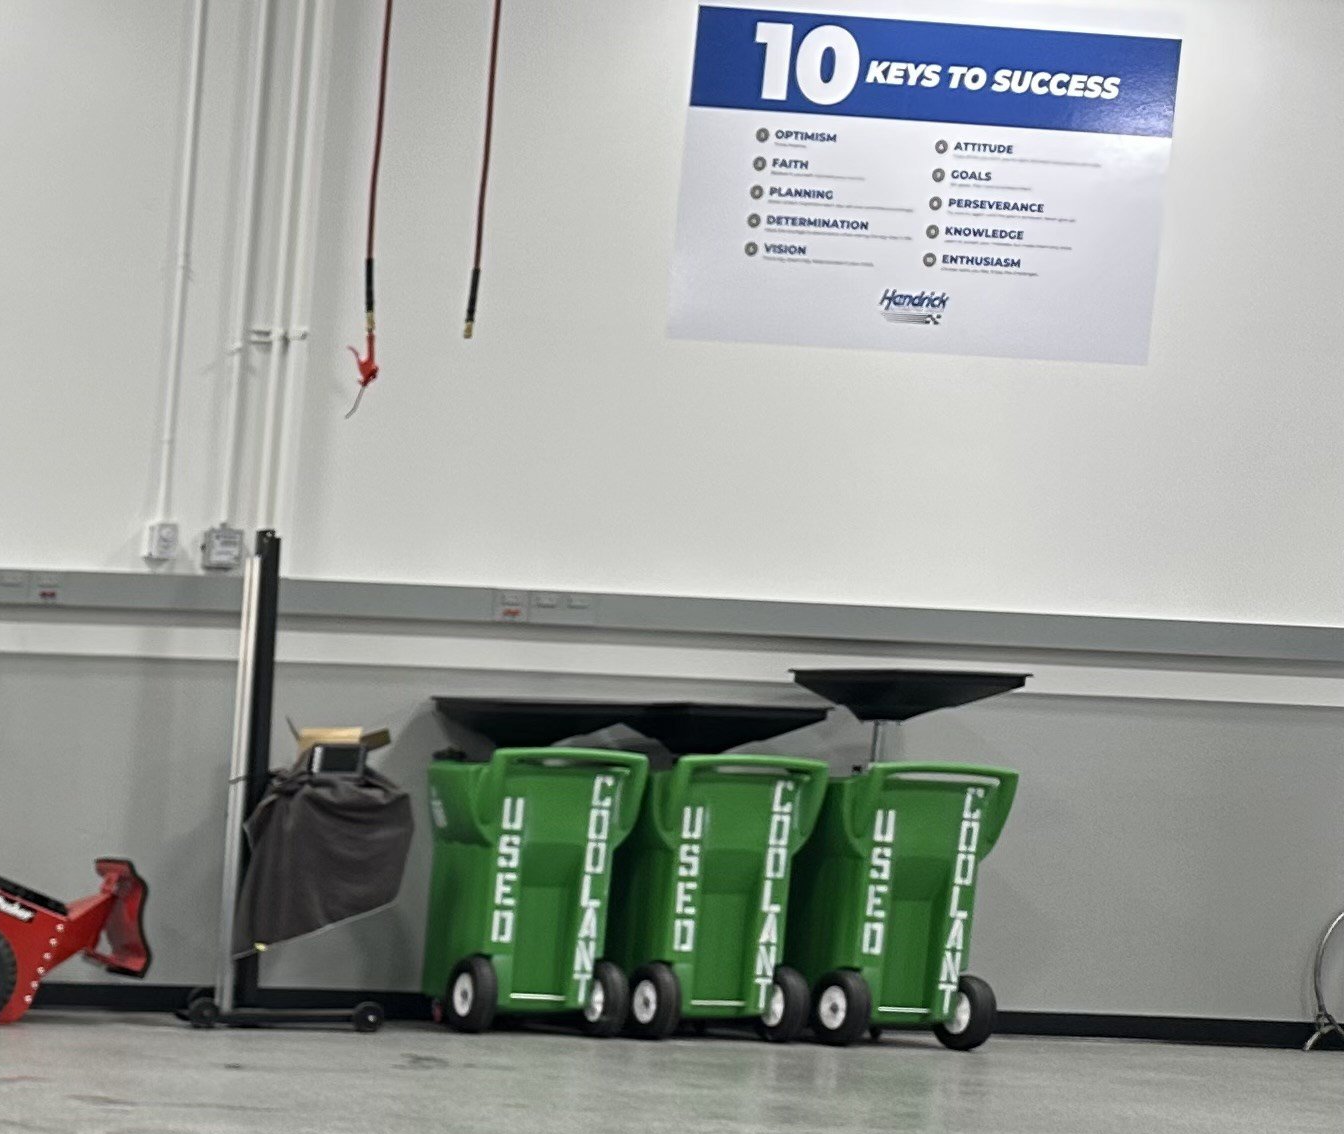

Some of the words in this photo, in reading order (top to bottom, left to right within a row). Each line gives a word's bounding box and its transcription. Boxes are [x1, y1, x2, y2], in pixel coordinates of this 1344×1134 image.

[756, 21, 861, 106] 10
[866, 60, 942, 89] KEYS
[948, 65, 988, 91] TO
[991, 68, 1121, 100] SUCCESS
[775, 129, 837, 143] OPTIMISM
[954, 141, 1014, 155] ATTITUDE
[771, 157, 809, 170] FAITH
[950, 169, 992, 182] GOALS
[768, 186, 834, 201] PLANNING
[947, 197, 1045, 214] PERSEVERANCE
[765, 214, 869, 231] DETERMINATION
[944, 226, 1025, 241] KNOWLEDGE
[764, 243, 807, 256] VISION
[941, 254, 1021, 269] ENTHUSIASM
[877, 288, 950, 311] Hendrick
[491, 796, 525, 944] USED
[673, 805, 705, 953] USED
[862, 808, 896, 957] USED
[572, 774, 615, 1006] COOLANT
[754, 780, 794, 1011] COOLANT
[938, 786, 985, 1015] COOLANT
